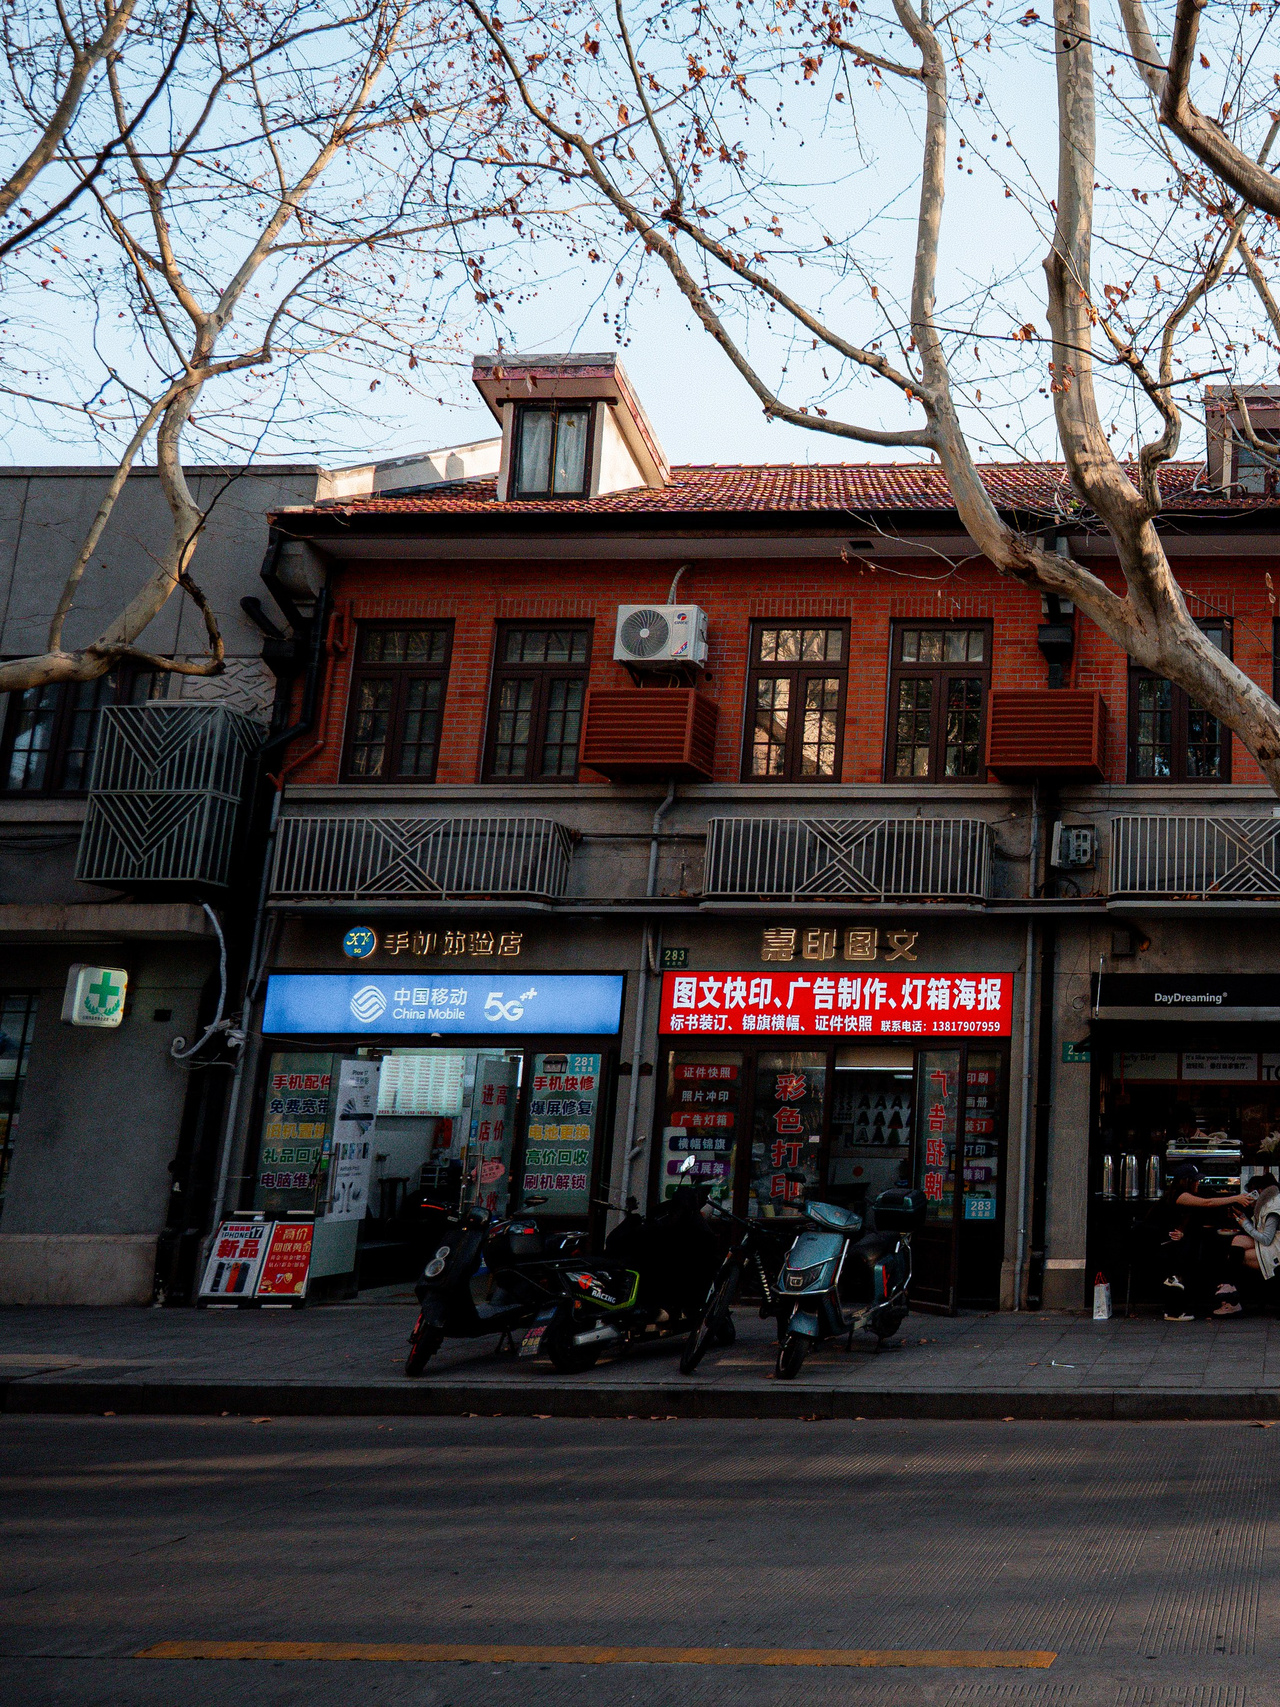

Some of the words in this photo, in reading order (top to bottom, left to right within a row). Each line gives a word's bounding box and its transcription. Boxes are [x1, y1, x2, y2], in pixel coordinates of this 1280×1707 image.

[761, 927, 919, 961] 嘉印图文
[664, 950, 685, 961] 283
[393, 987, 468, 1005] 中国移动
[672, 975, 1002, 1010] 图文快印、广告制作、灯箱海报
[393, 1008, 425, 1020] China
[428, 1008, 465, 1020] Mobile
[574, 1057, 594, 1066] 281
[683, 1066, 731, 1078] 证件快照
[533, 1075, 595, 1091] 手机快修
[681, 1090, 730, 1102] 照片冲印
[530, 1100, 593, 1116] 爆屏修复
[679, 1114, 728, 1126] 广告灯箱
[528, 1124, 591, 1141] 电池更换
[769, 1073, 807, 1201] 彩色打印
[678, 1138, 726, 1150] 横幅锦旗
[525, 1149, 589, 1166] 高价回收
[675, 1162, 724, 1174] 板展架
[522, 1174, 587, 1191] 刷机解锁
[970, 1201, 991, 1211] 283
[249, 1226, 264, 1239] 17
[282, 1227, 308, 1241] 高价
[216, 1238, 260, 1258] 新品
[272, 1240, 312, 1253] 回收黄金
